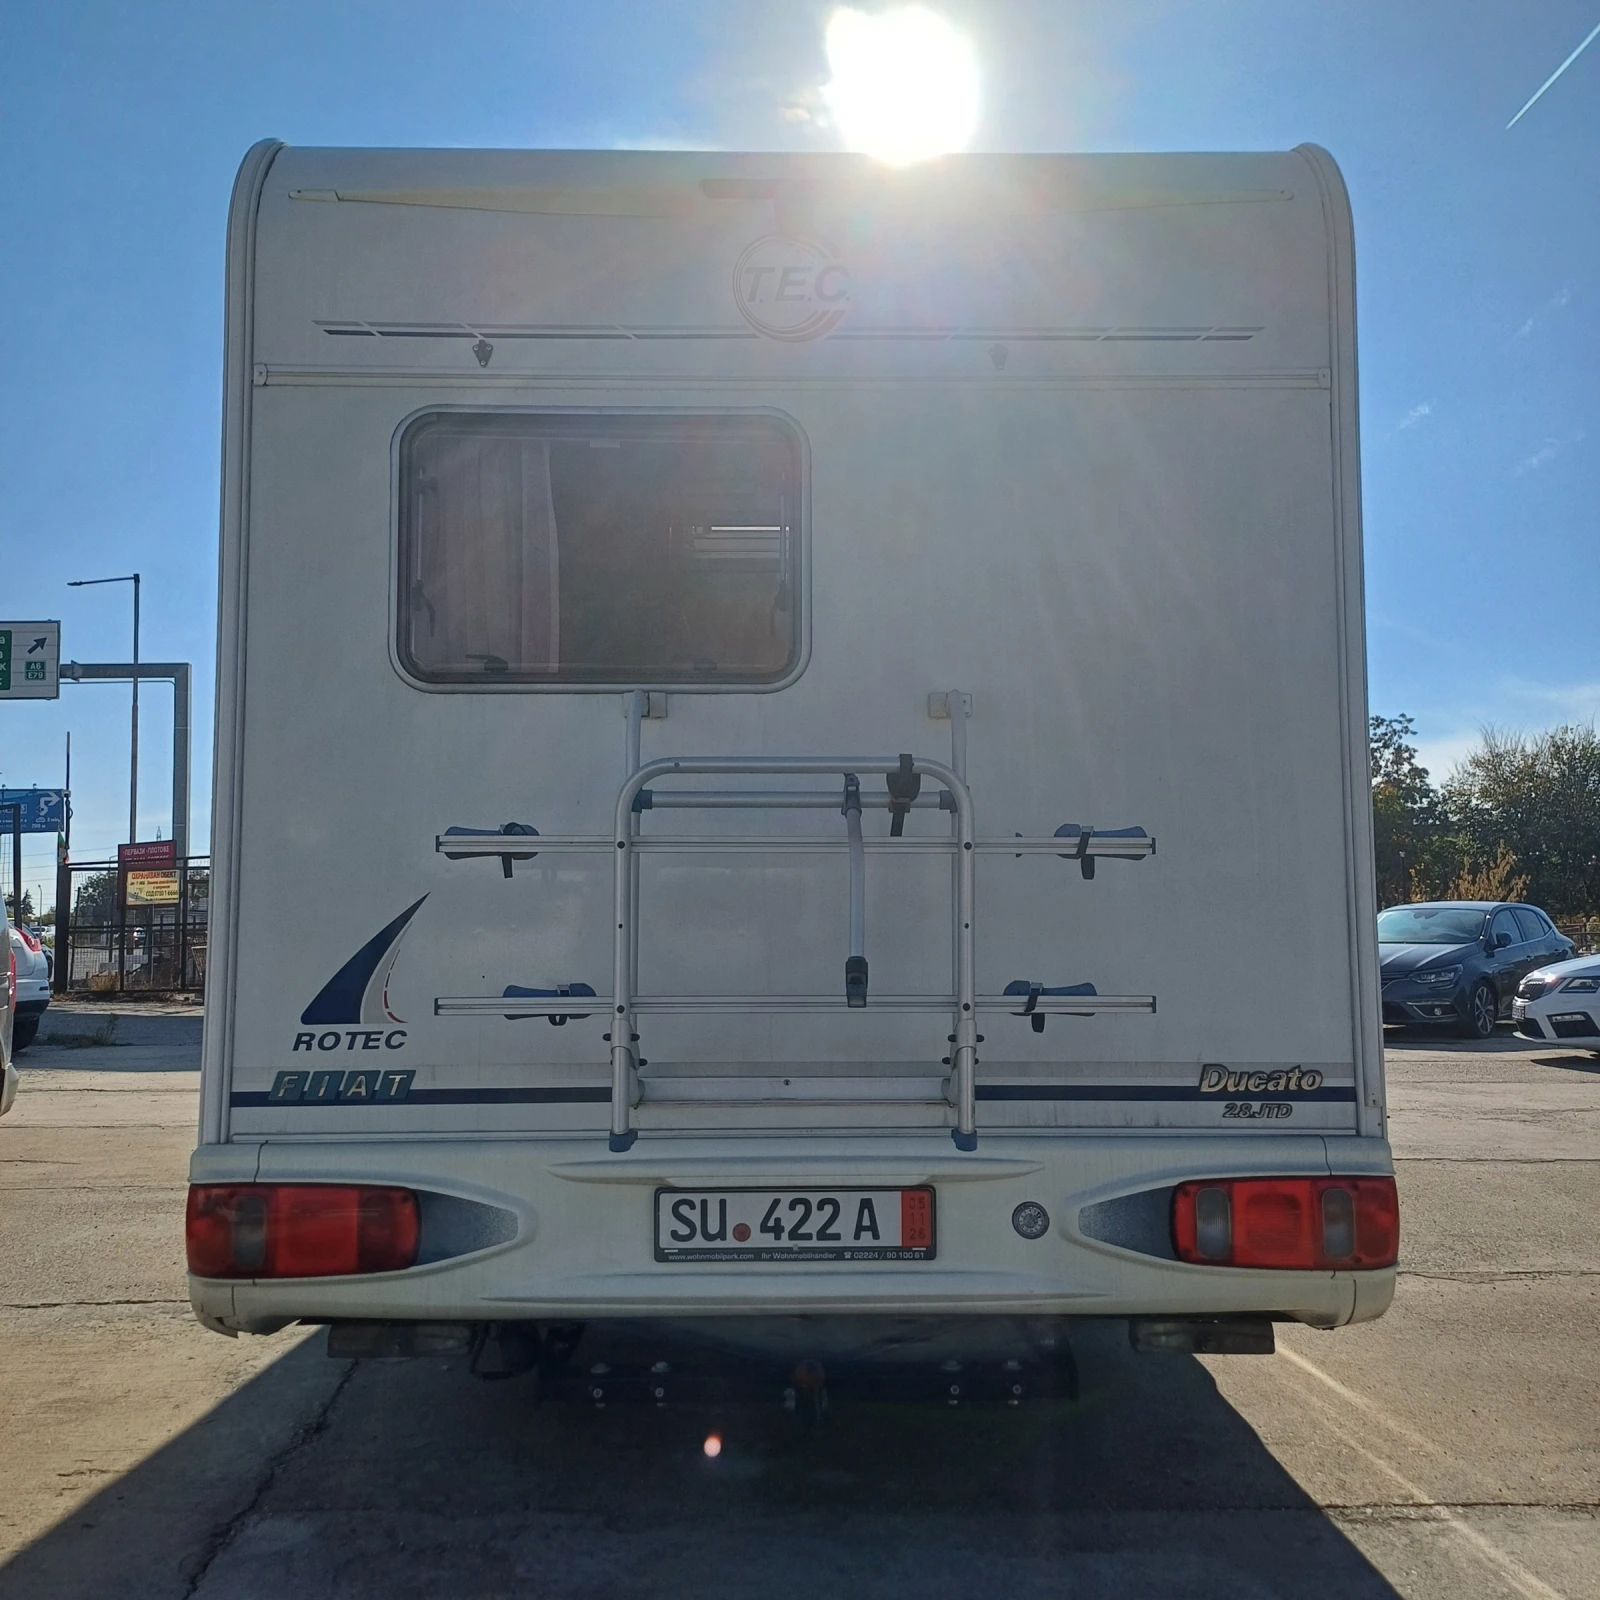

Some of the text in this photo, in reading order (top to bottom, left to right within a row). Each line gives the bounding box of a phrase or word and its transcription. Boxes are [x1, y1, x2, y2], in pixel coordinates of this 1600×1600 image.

[30, 662, 41, 670] A6
[292, 1030, 408, 1051] ROTEC
[276, 1074, 409, 1098] FIAT
[1200, 1063, 1324, 1093] Ducato
[670, 1197, 881, 1243] SU 422 A
[668, 1252, 755, 1261] www.wohnmobilpark.com
[853, 1251, 878, 1259] 02224
[898, 1251, 914, 1259] 100
